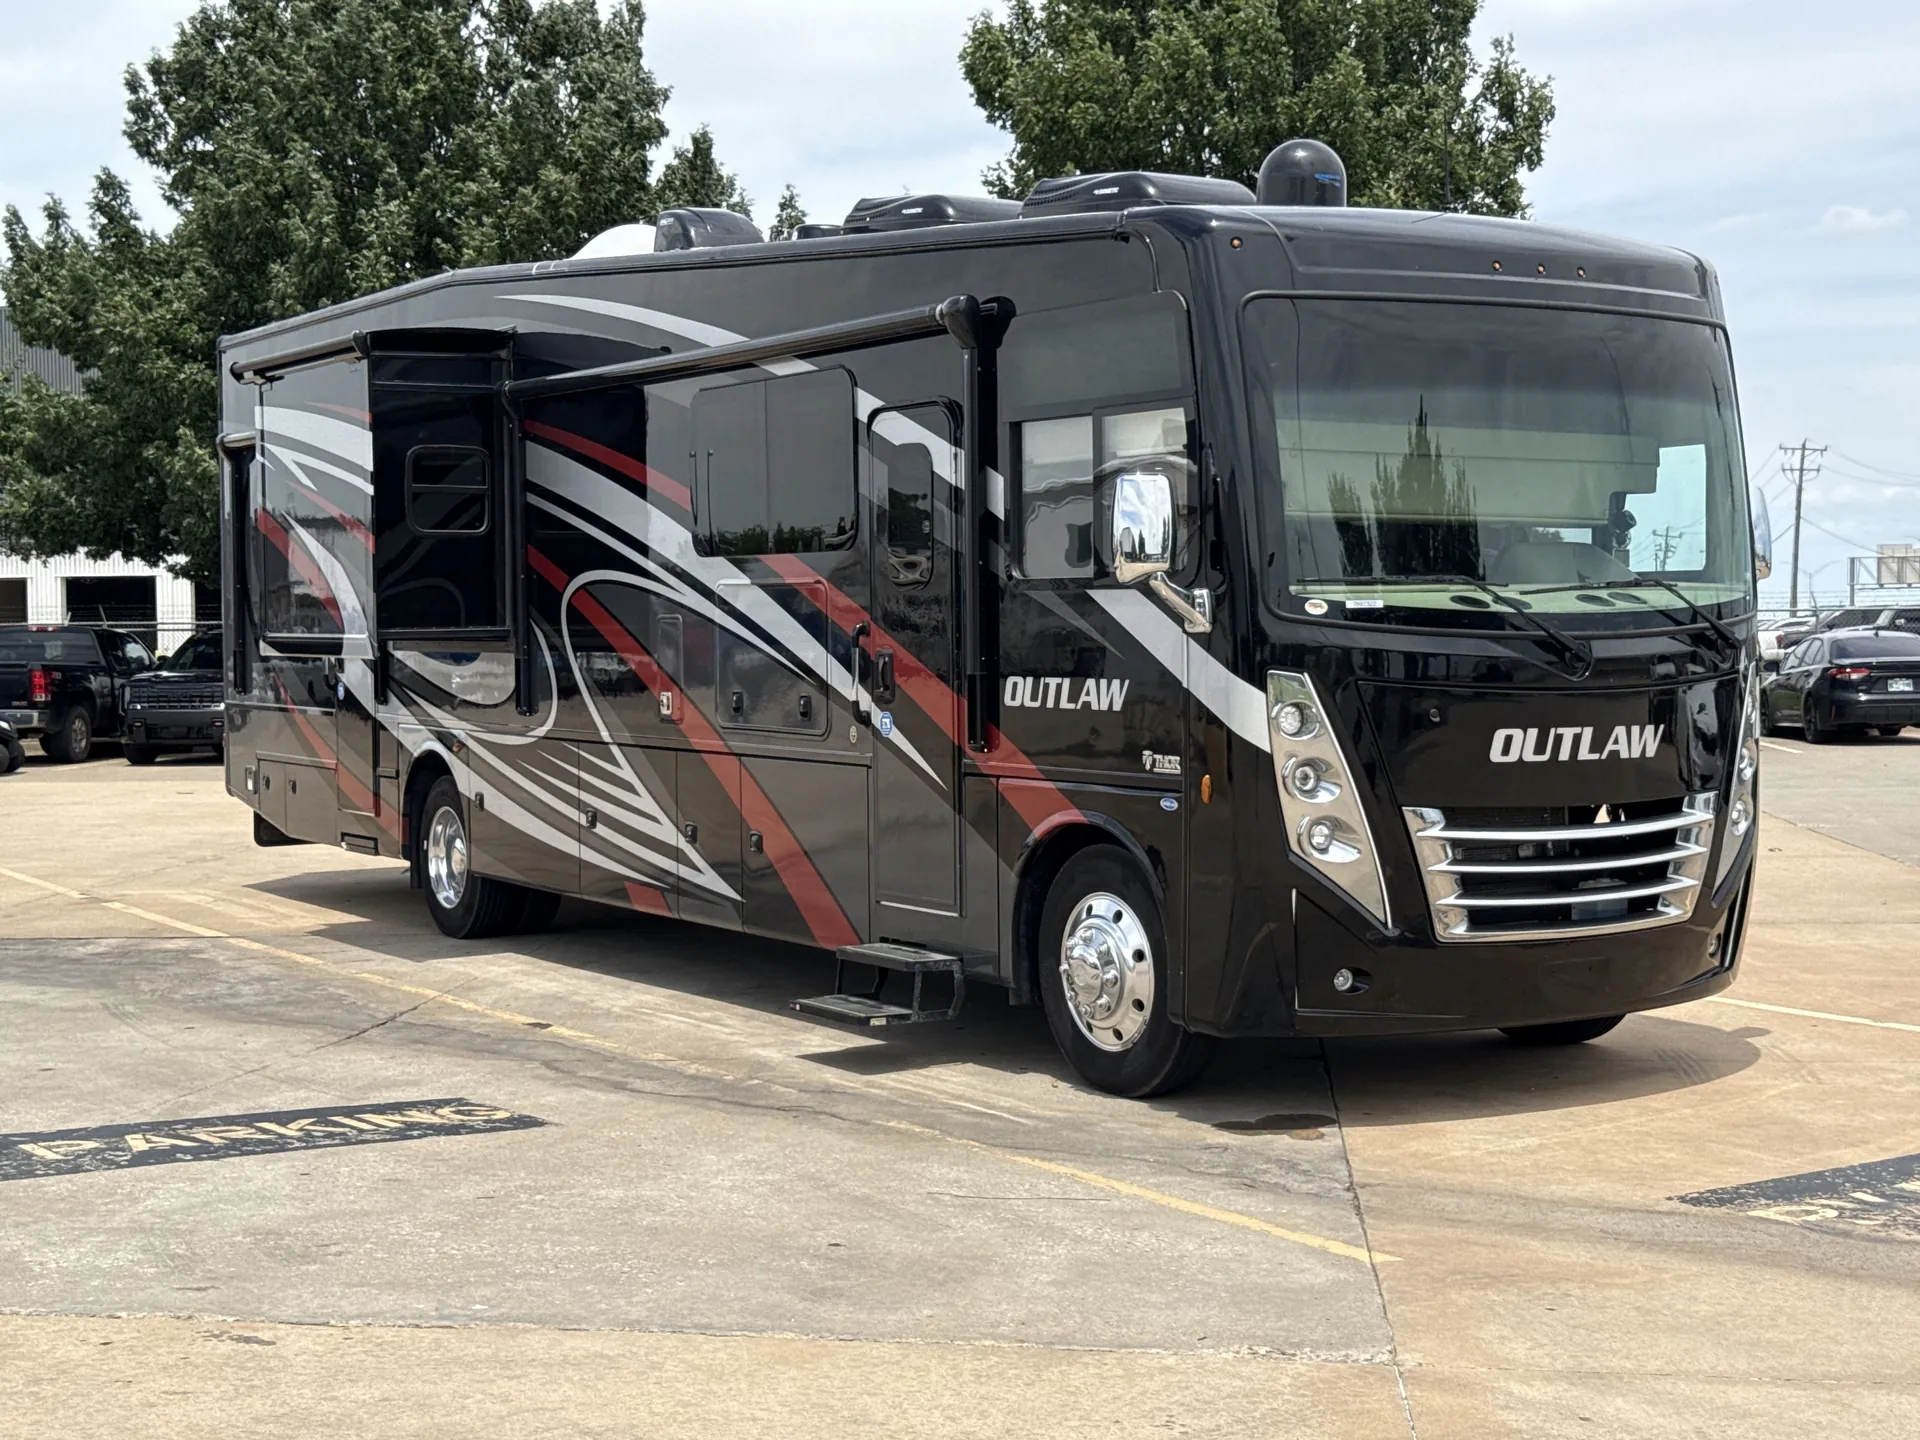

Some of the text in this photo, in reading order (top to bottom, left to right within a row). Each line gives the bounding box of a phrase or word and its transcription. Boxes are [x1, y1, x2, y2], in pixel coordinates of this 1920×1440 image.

[1004, 676, 1130, 711] OUTLAW
[1489, 724, 1665, 763] OUTLAW
[18, 1105, 512, 1161] PARKING
